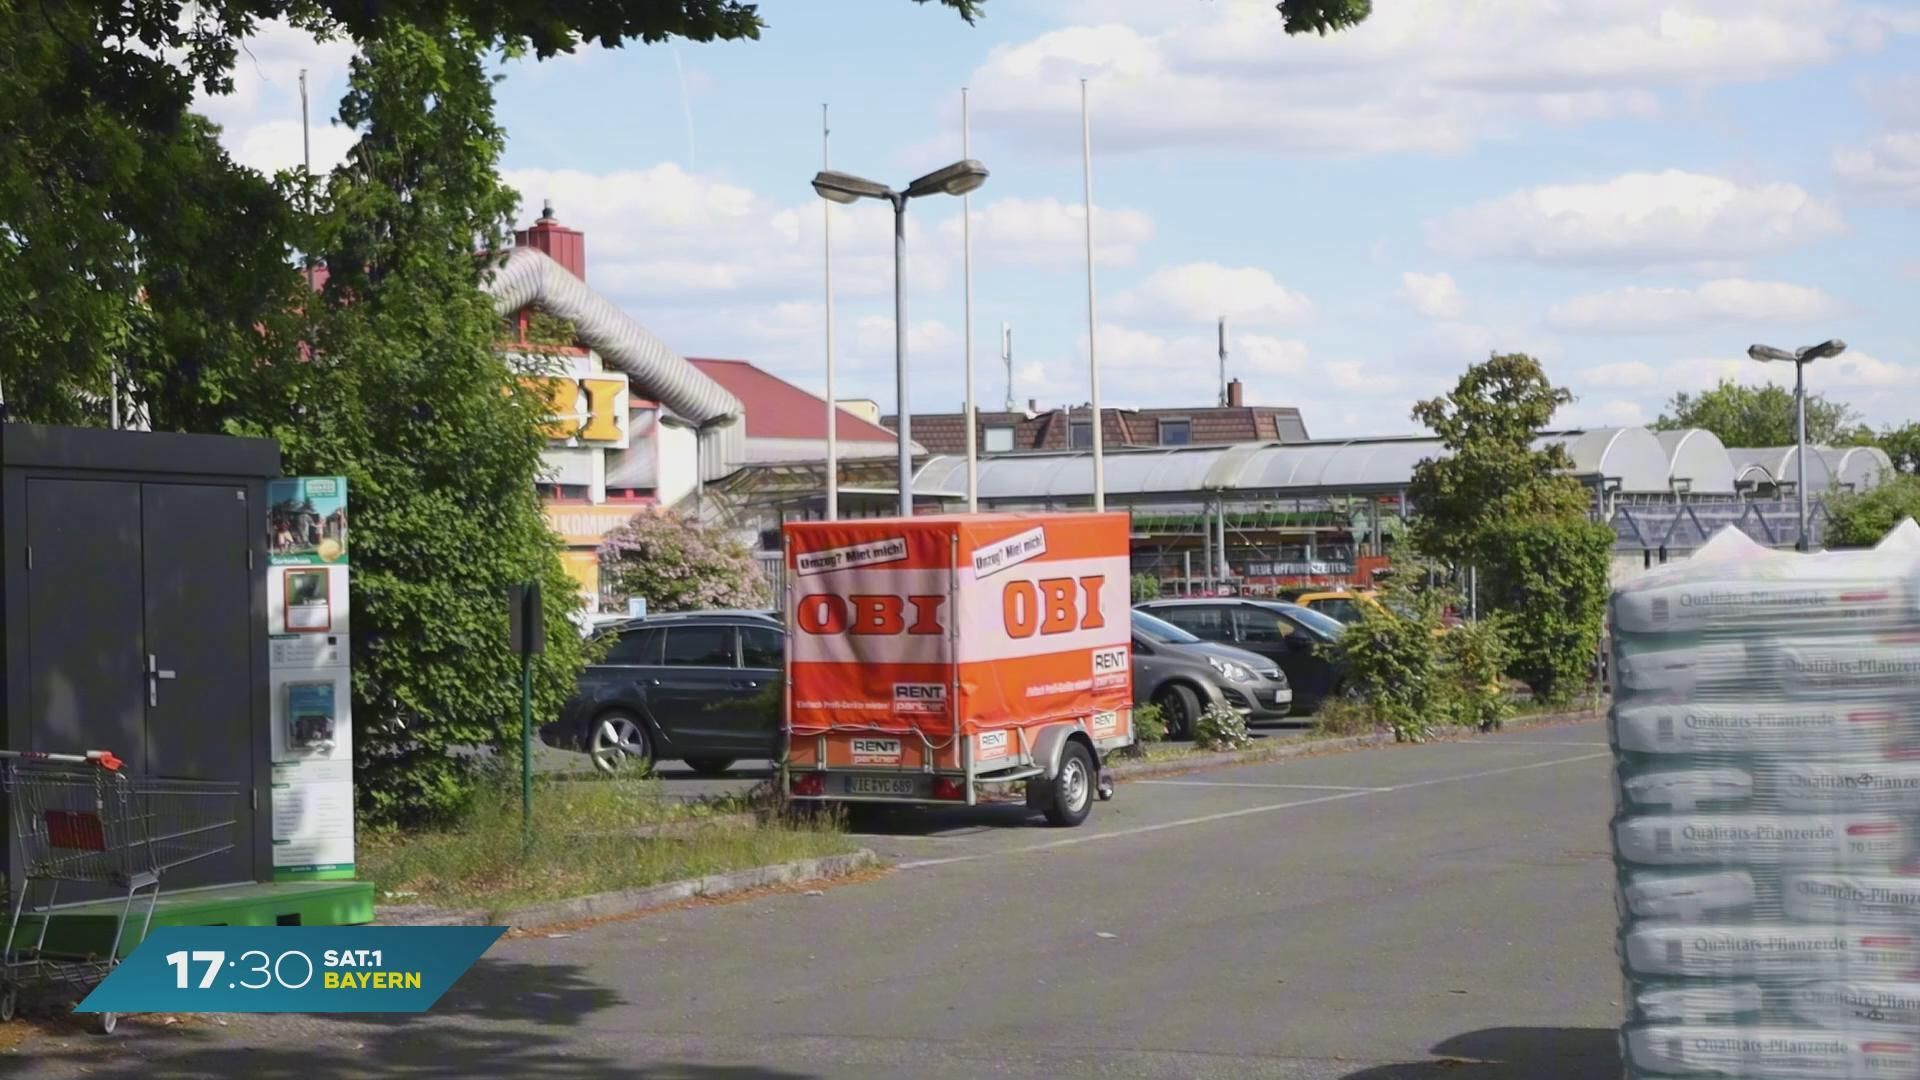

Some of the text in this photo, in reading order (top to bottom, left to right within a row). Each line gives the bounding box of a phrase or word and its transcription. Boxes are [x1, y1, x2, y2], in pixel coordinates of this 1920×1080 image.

[800, 542, 904, 570] Umzug? Miet mich!
[797, 593, 946, 636] OBI
[1002, 575, 1106, 640] OBI
[1095, 651, 1126, 669] RENT
[895, 685, 944, 699] RENT
[1095, 713, 1115, 727] RENT
[853, 740, 898, 752] RENT
[981, 731, 1006, 747] RENT
